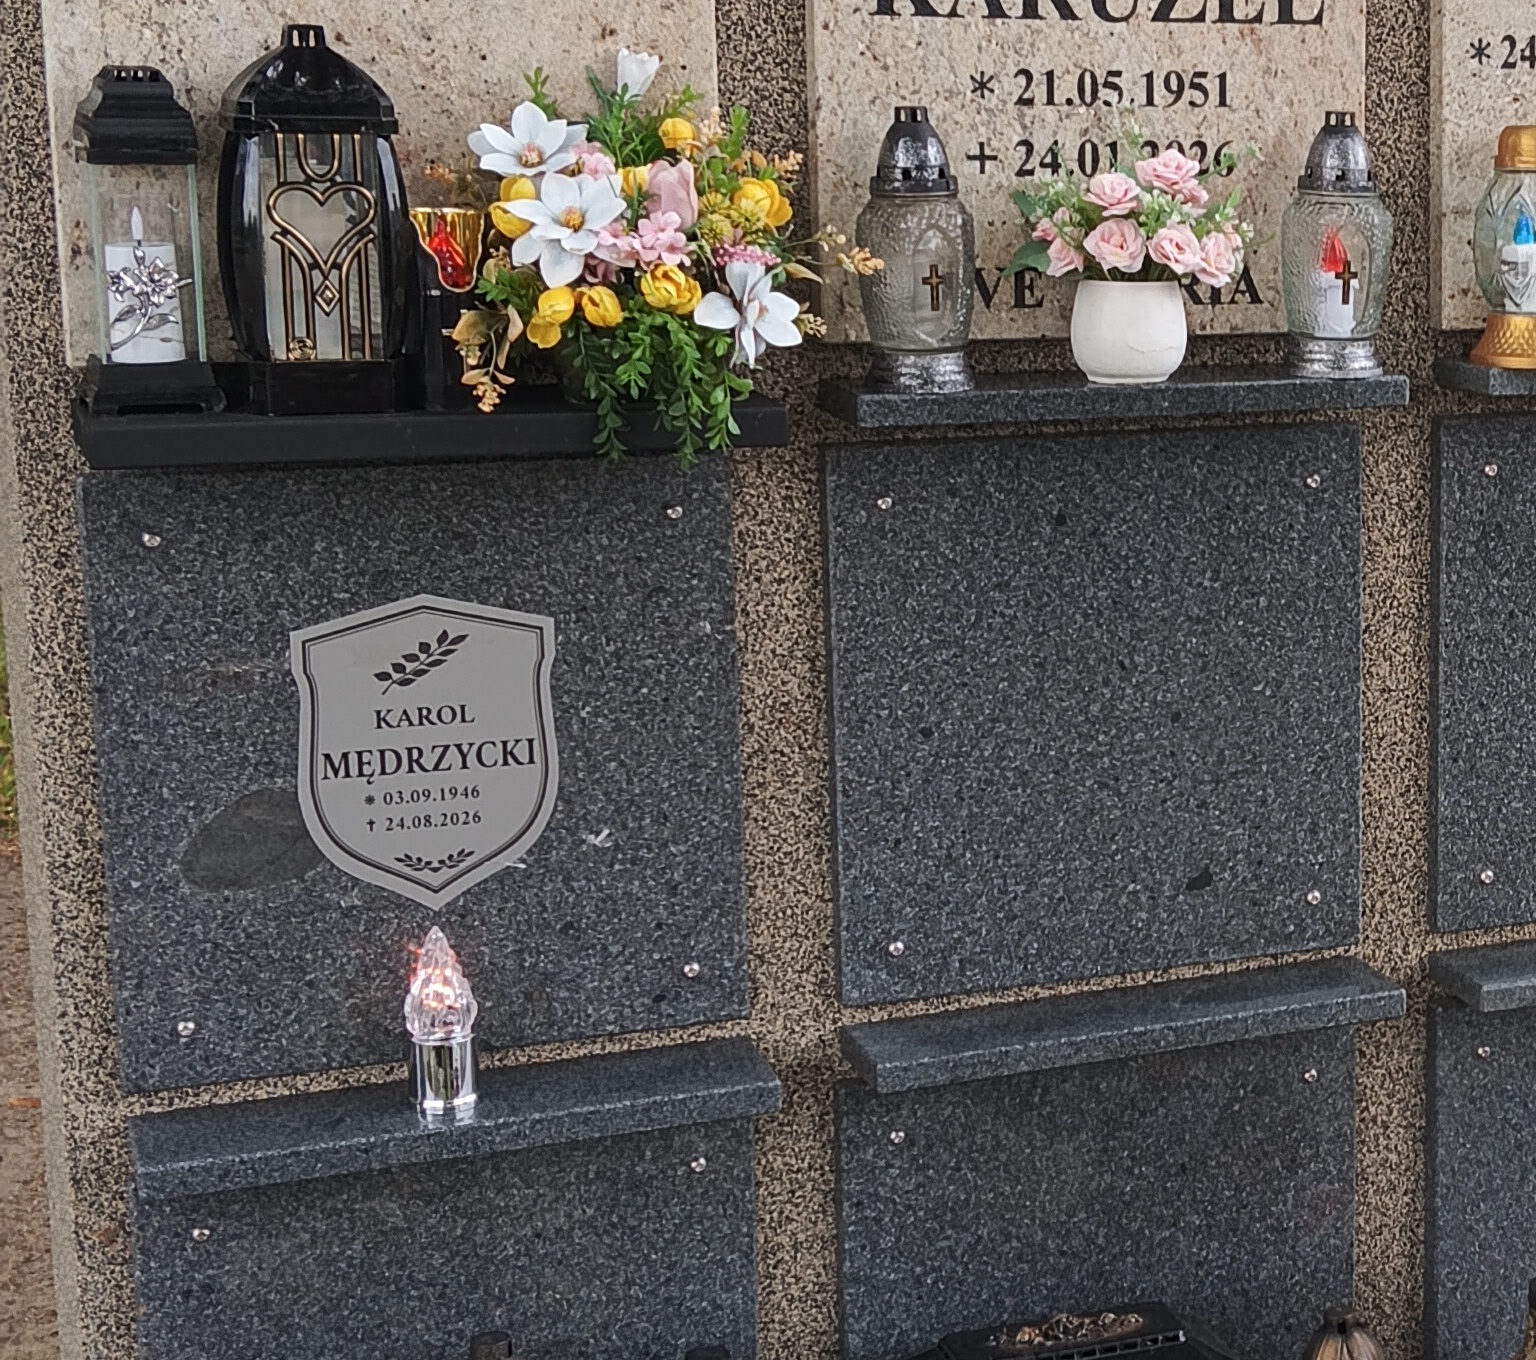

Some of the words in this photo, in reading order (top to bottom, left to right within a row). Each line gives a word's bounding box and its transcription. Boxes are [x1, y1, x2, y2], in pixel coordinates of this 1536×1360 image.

[974, 267, 1044, 310] VE
[374, 704, 475, 730] KAROL
[321, 738, 536, 785] MĘDRZYCKI
[383, 785, 480, 805] 03.09.1946
[385, 810, 482, 831] 24.08.2026
